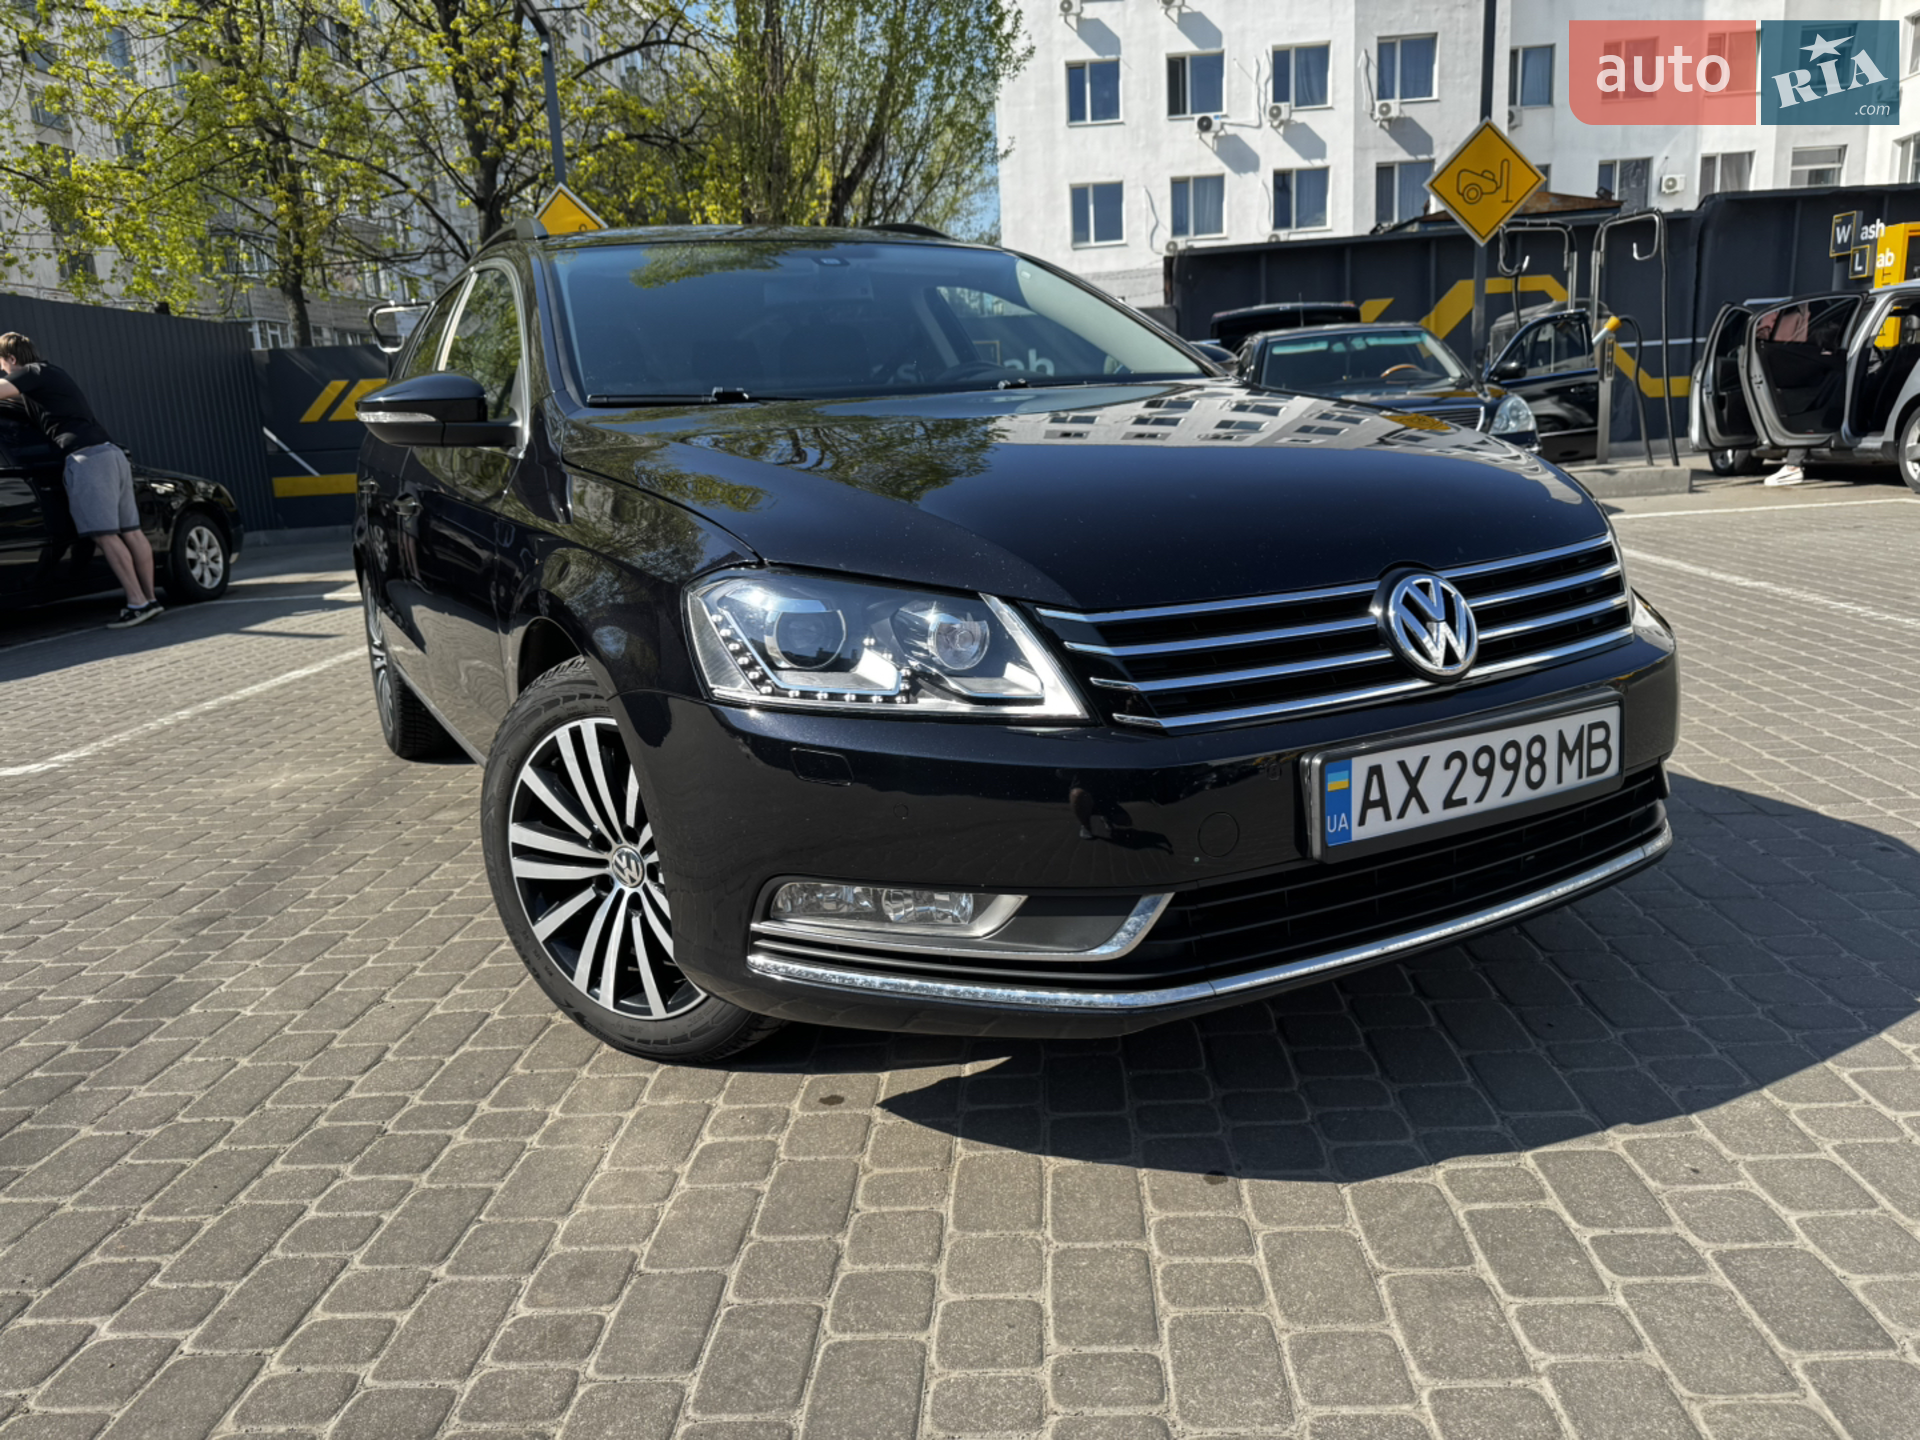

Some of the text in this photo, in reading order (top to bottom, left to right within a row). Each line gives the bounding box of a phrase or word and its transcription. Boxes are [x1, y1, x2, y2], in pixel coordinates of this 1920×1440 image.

[1357, 720, 1612, 827] AX 2998 MB
[1327, 812, 1349, 833] UA
